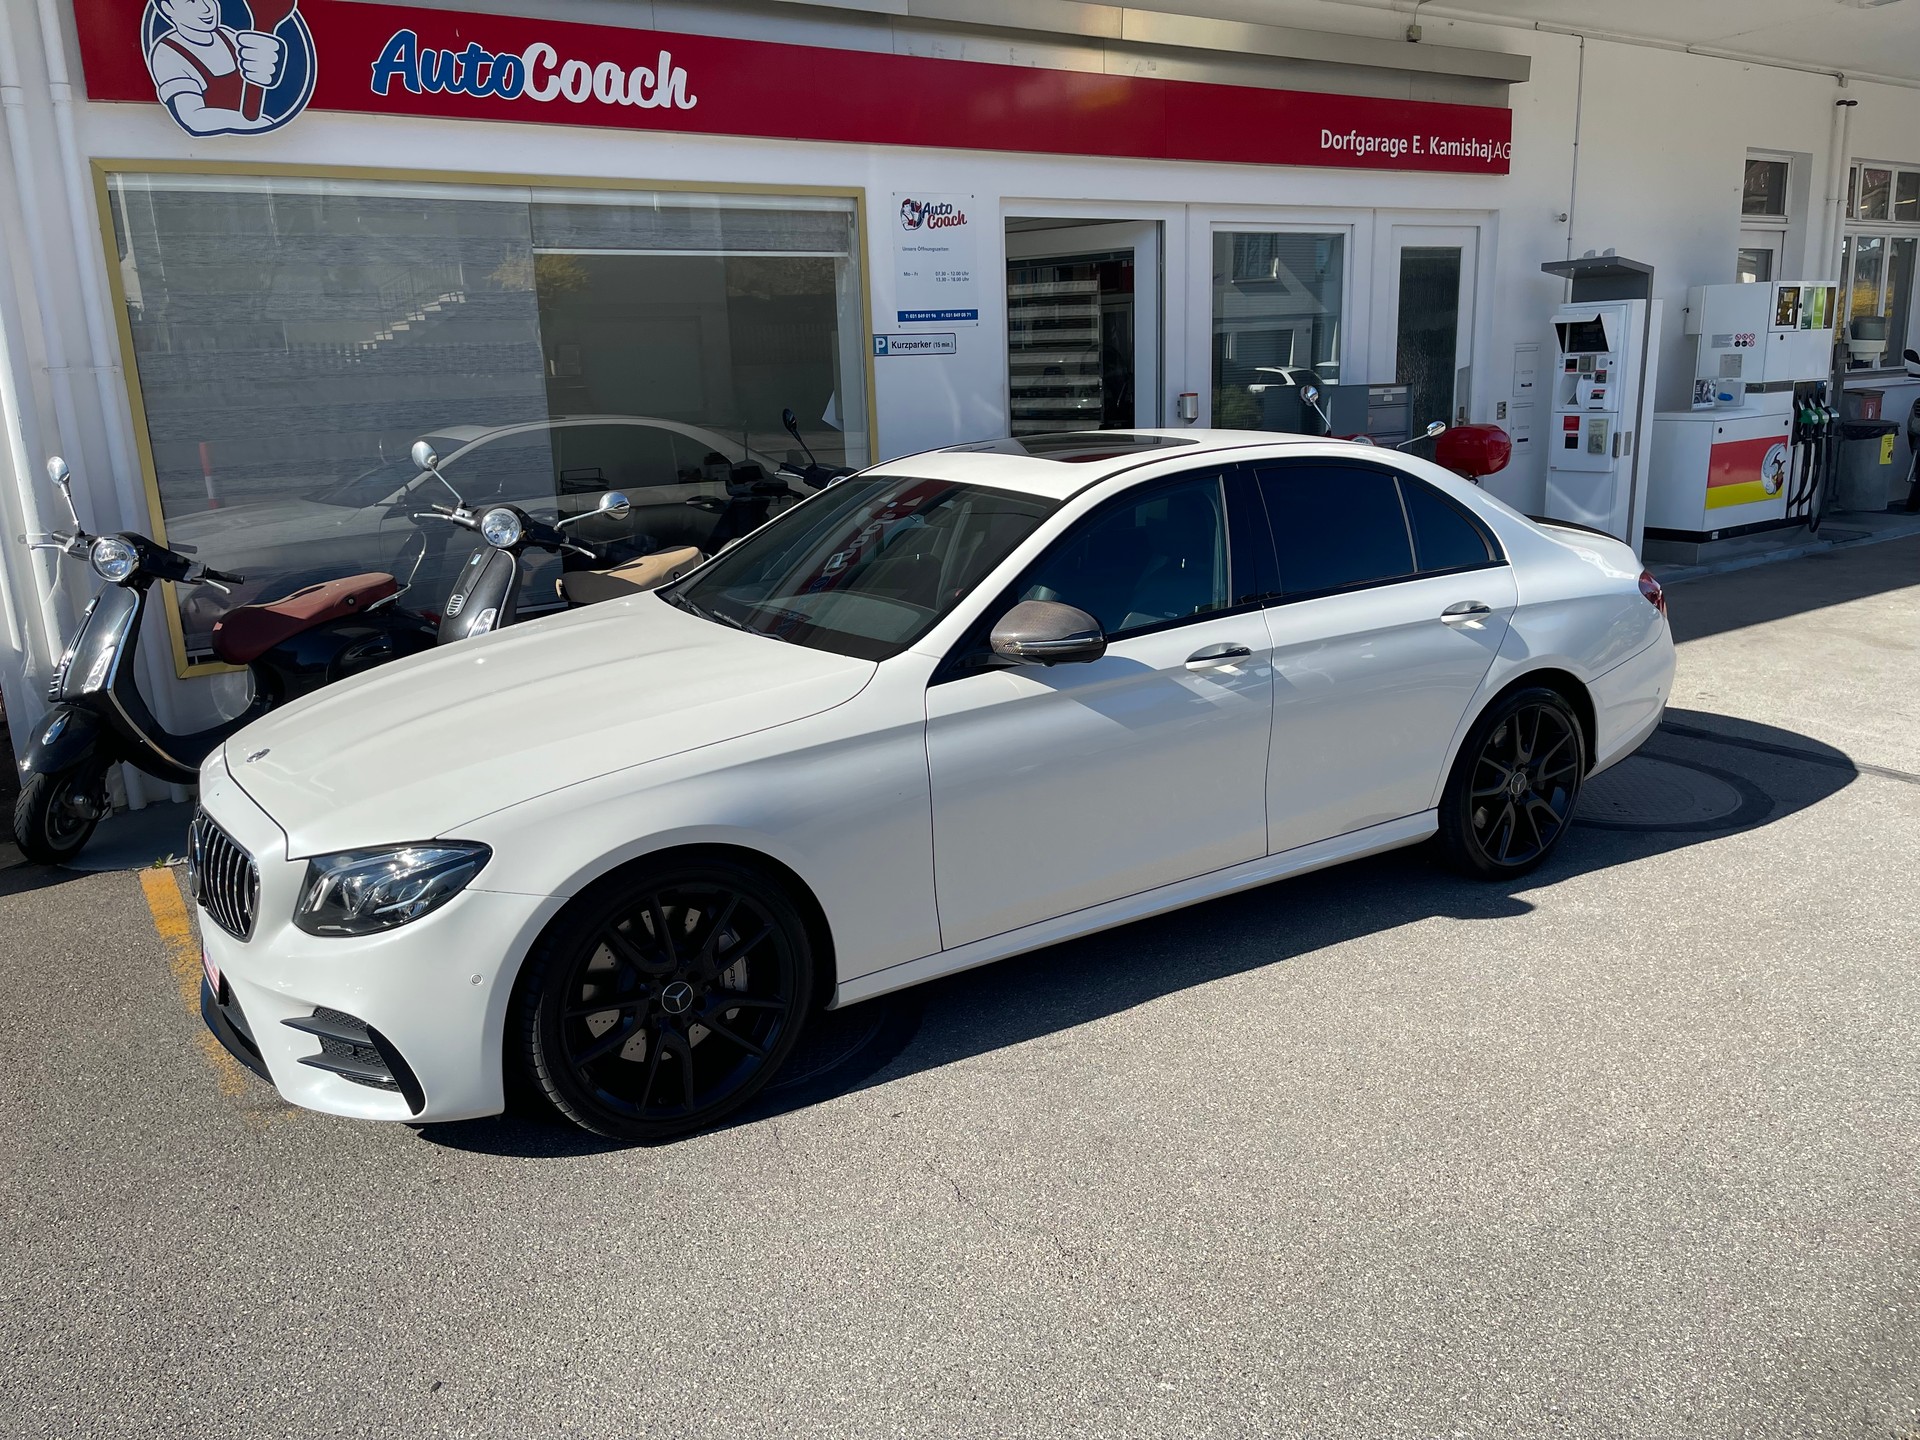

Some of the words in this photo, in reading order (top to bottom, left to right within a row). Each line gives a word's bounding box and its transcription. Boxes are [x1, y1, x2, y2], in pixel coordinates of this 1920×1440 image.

[1320, 129, 1408, 157] Dorfgarage
[1412, 135, 1425, 155] E.
[922, 202, 953, 219] Auto
[927, 210, 968, 230] Coach
[875, 337, 886, 354] P
[891, 340, 932, 351] Kurzparker
